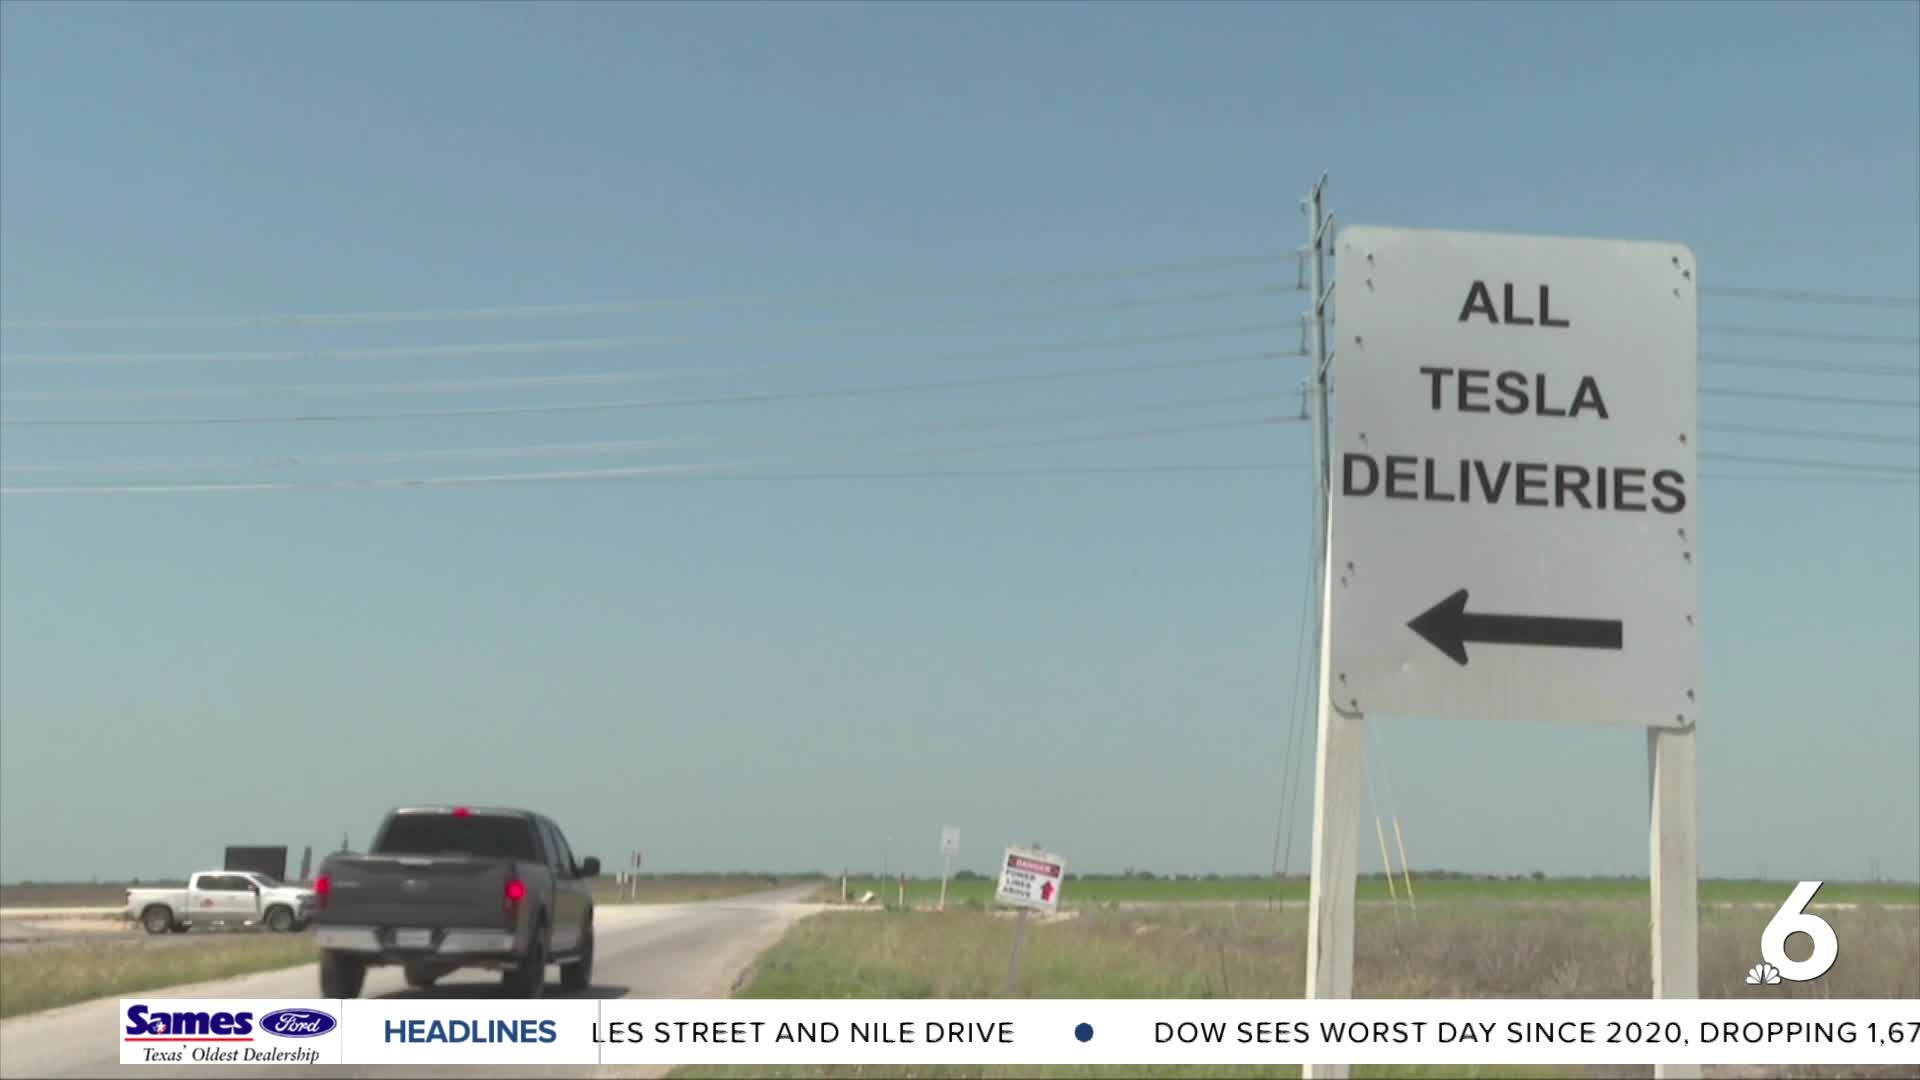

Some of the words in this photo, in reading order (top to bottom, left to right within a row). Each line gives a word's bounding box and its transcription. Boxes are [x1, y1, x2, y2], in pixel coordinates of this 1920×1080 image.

[1458, 280, 1570, 328] ALL
[1419, 366, 1609, 420] TESLA
[1342, 452, 1687, 515] DELIVERIES
[1014, 858, 1051, 874] DANGER
